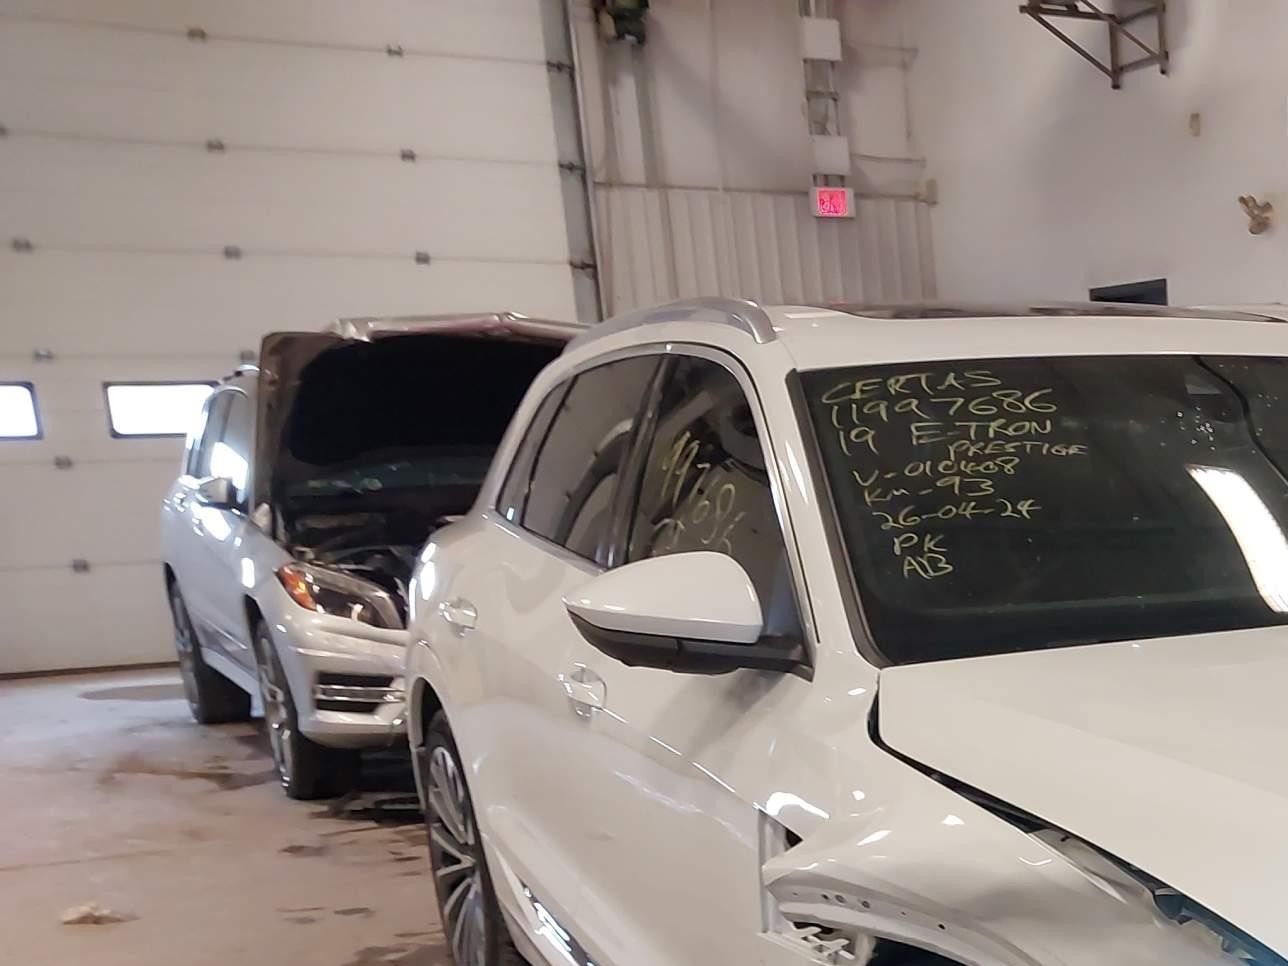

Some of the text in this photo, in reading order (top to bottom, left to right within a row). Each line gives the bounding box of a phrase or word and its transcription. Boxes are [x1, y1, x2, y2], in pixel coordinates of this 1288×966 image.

[839, 419, 1052, 456] 19 E-TRON
[949, 442, 1088, 461] PRESTIGE
